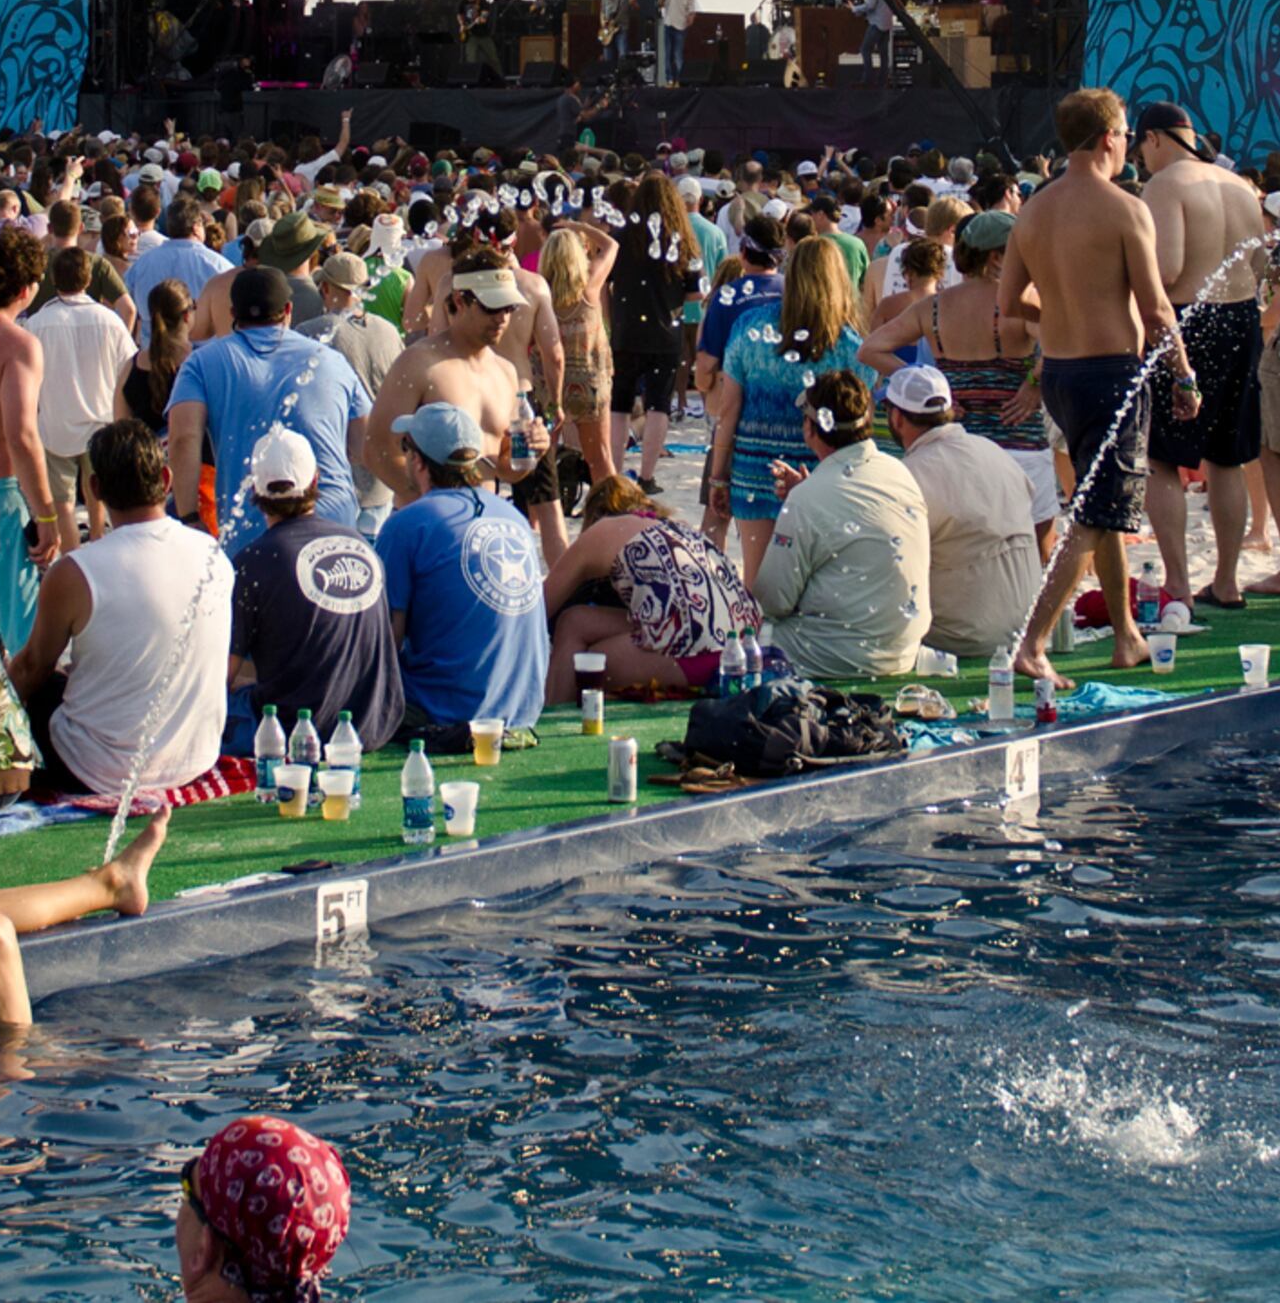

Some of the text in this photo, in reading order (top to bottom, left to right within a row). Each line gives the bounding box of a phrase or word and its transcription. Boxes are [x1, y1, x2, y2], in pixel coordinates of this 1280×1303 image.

[1010, 751, 1025, 792] 4
[323, 890, 363, 944] 5 FT
